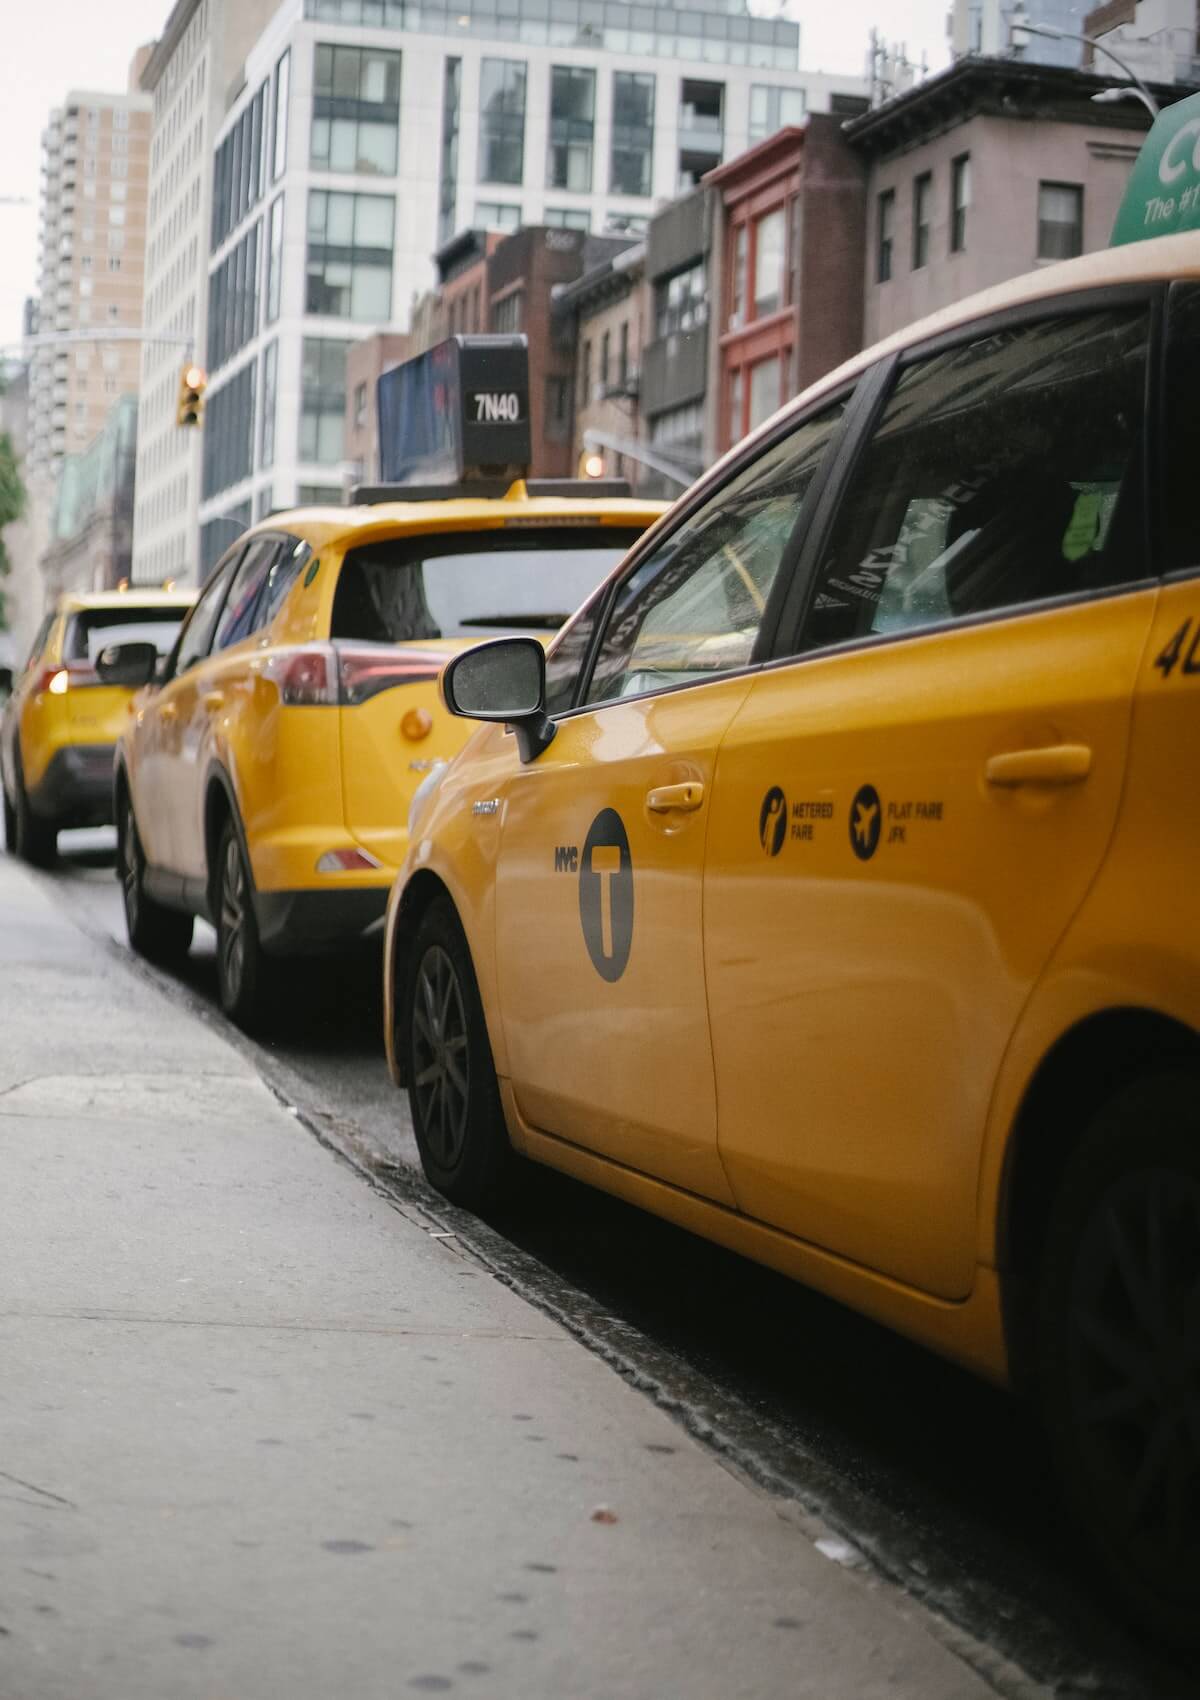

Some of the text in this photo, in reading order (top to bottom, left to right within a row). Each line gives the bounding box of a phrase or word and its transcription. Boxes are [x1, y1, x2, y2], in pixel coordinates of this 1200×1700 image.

[1144, 196, 1174, 224] The
[474, 392, 519, 421] 7N40
[792, 802, 833, 819] METERED
[887, 801, 944, 821] FLAT FARE
[791, 824, 813, 840] FARE
[555, 846, 578, 873] NYC
